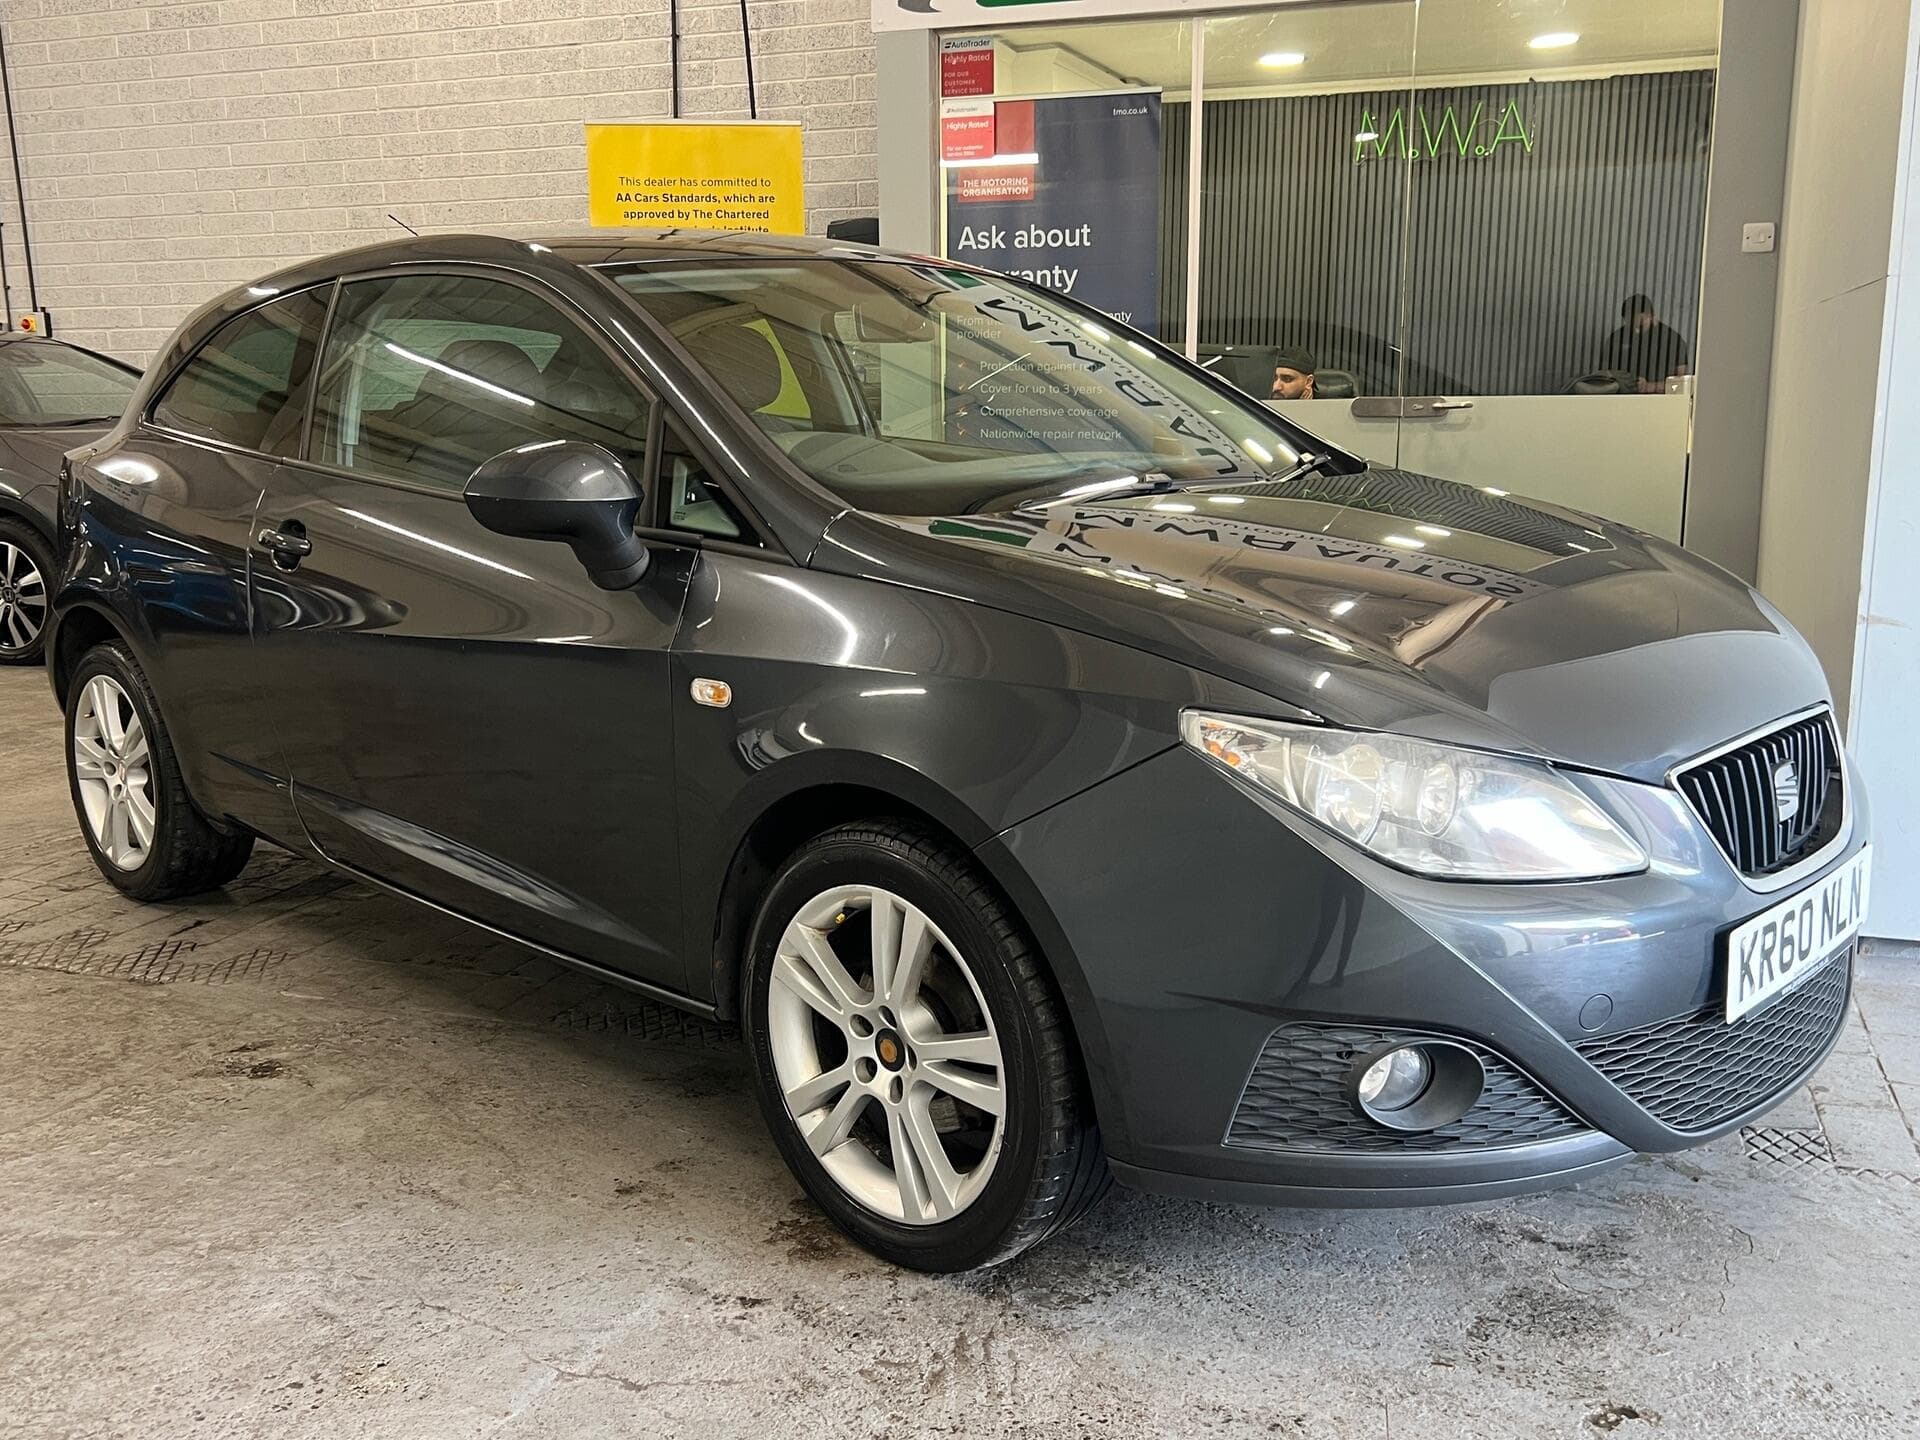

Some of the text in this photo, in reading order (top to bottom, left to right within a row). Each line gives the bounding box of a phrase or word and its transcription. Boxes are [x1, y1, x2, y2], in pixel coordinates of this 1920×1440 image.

[951, 39, 990, 48] AutoTrader
[944, 53, 990, 64] Highly Rated
[1113, 106, 1148, 116] tmo.co.uk
[946, 120, 989, 131] Highly Rated
[618, 177, 771, 187] This dealer has committed to
[963, 177, 1028, 188] THE MOTORING
[962, 186, 1029, 197] ORGANISATION
[616, 193, 775, 204] AA Cars Standards, which are
[623, 209, 769, 220] approved by The Chartered
[957, 223, 1092, 250] Ask about
[956, 316, 983, 326] From
[956, 327, 1002, 340] provider
[1037, 361, 1077, 373] against
[980, 383, 1103, 397] Cover for up to 3 years
[980, 406, 1119, 419] Comprehensive coverage
[980, 428, 1122, 441] Nationwide repair network
[1740, 898, 1814, 1003] KR60
[1820, 860, 1864, 948] NLN
